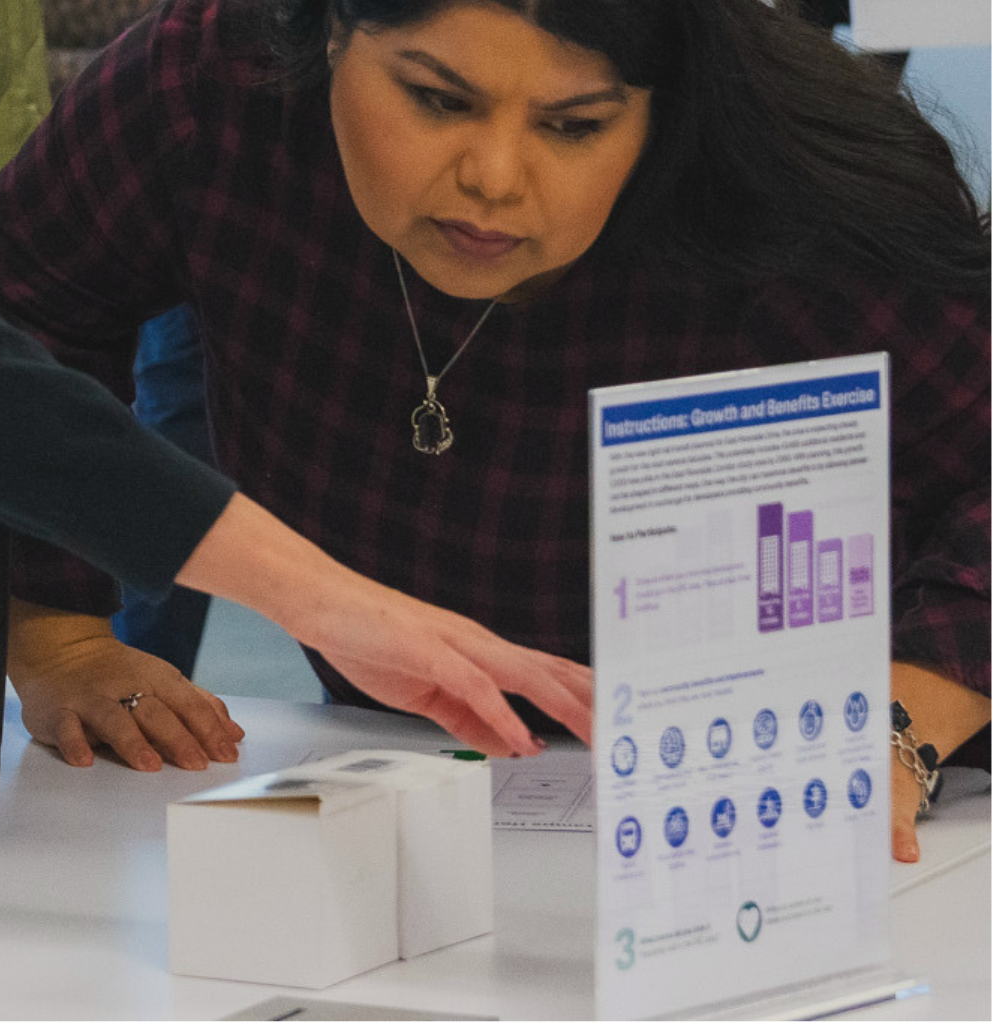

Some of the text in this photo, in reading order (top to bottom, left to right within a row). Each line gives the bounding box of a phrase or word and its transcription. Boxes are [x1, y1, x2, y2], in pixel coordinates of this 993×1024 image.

[604, 387, 876, 438] Instructions: Growth and Benefits Exercise
[613, 576, 628, 620] 1
[613, 683, 634, 726] 2
[615, 927, 636, 970] 3
